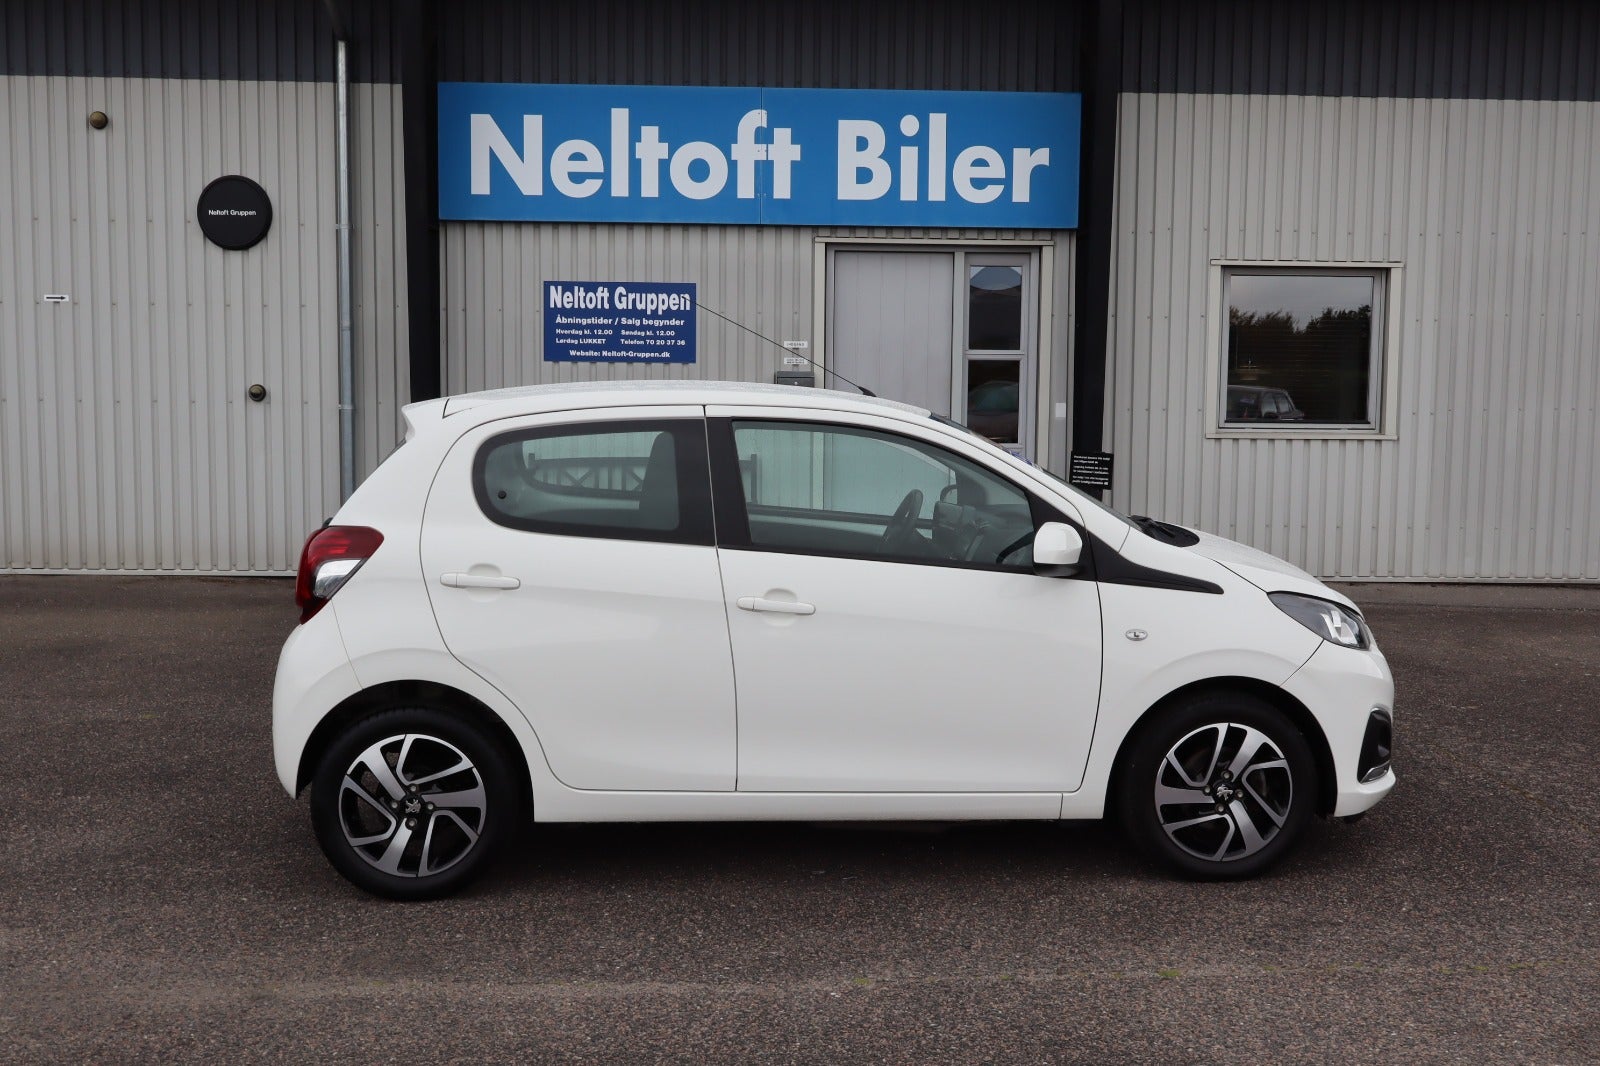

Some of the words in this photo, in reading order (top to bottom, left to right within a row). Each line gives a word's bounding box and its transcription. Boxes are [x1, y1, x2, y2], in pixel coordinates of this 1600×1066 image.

[470, 107, 802, 200] Neltoft
[836, 113, 1050, 204] Biler
[230, 209, 257, 217] Gruppen
[549, 285, 610, 310] Neltoft
[614, 286, 691, 315] Gruppen
[555, 314, 613, 325] Åbningstider
[614, 317, 619, 326] /
[620, 317, 641, 326] Salg
[642, 318, 685, 327] begynder
[555, 328, 583, 336] Hverdag
[569, 349, 601, 357] Website:
[601, 350, 671, 359] Neltoft-Gruppen.dk
